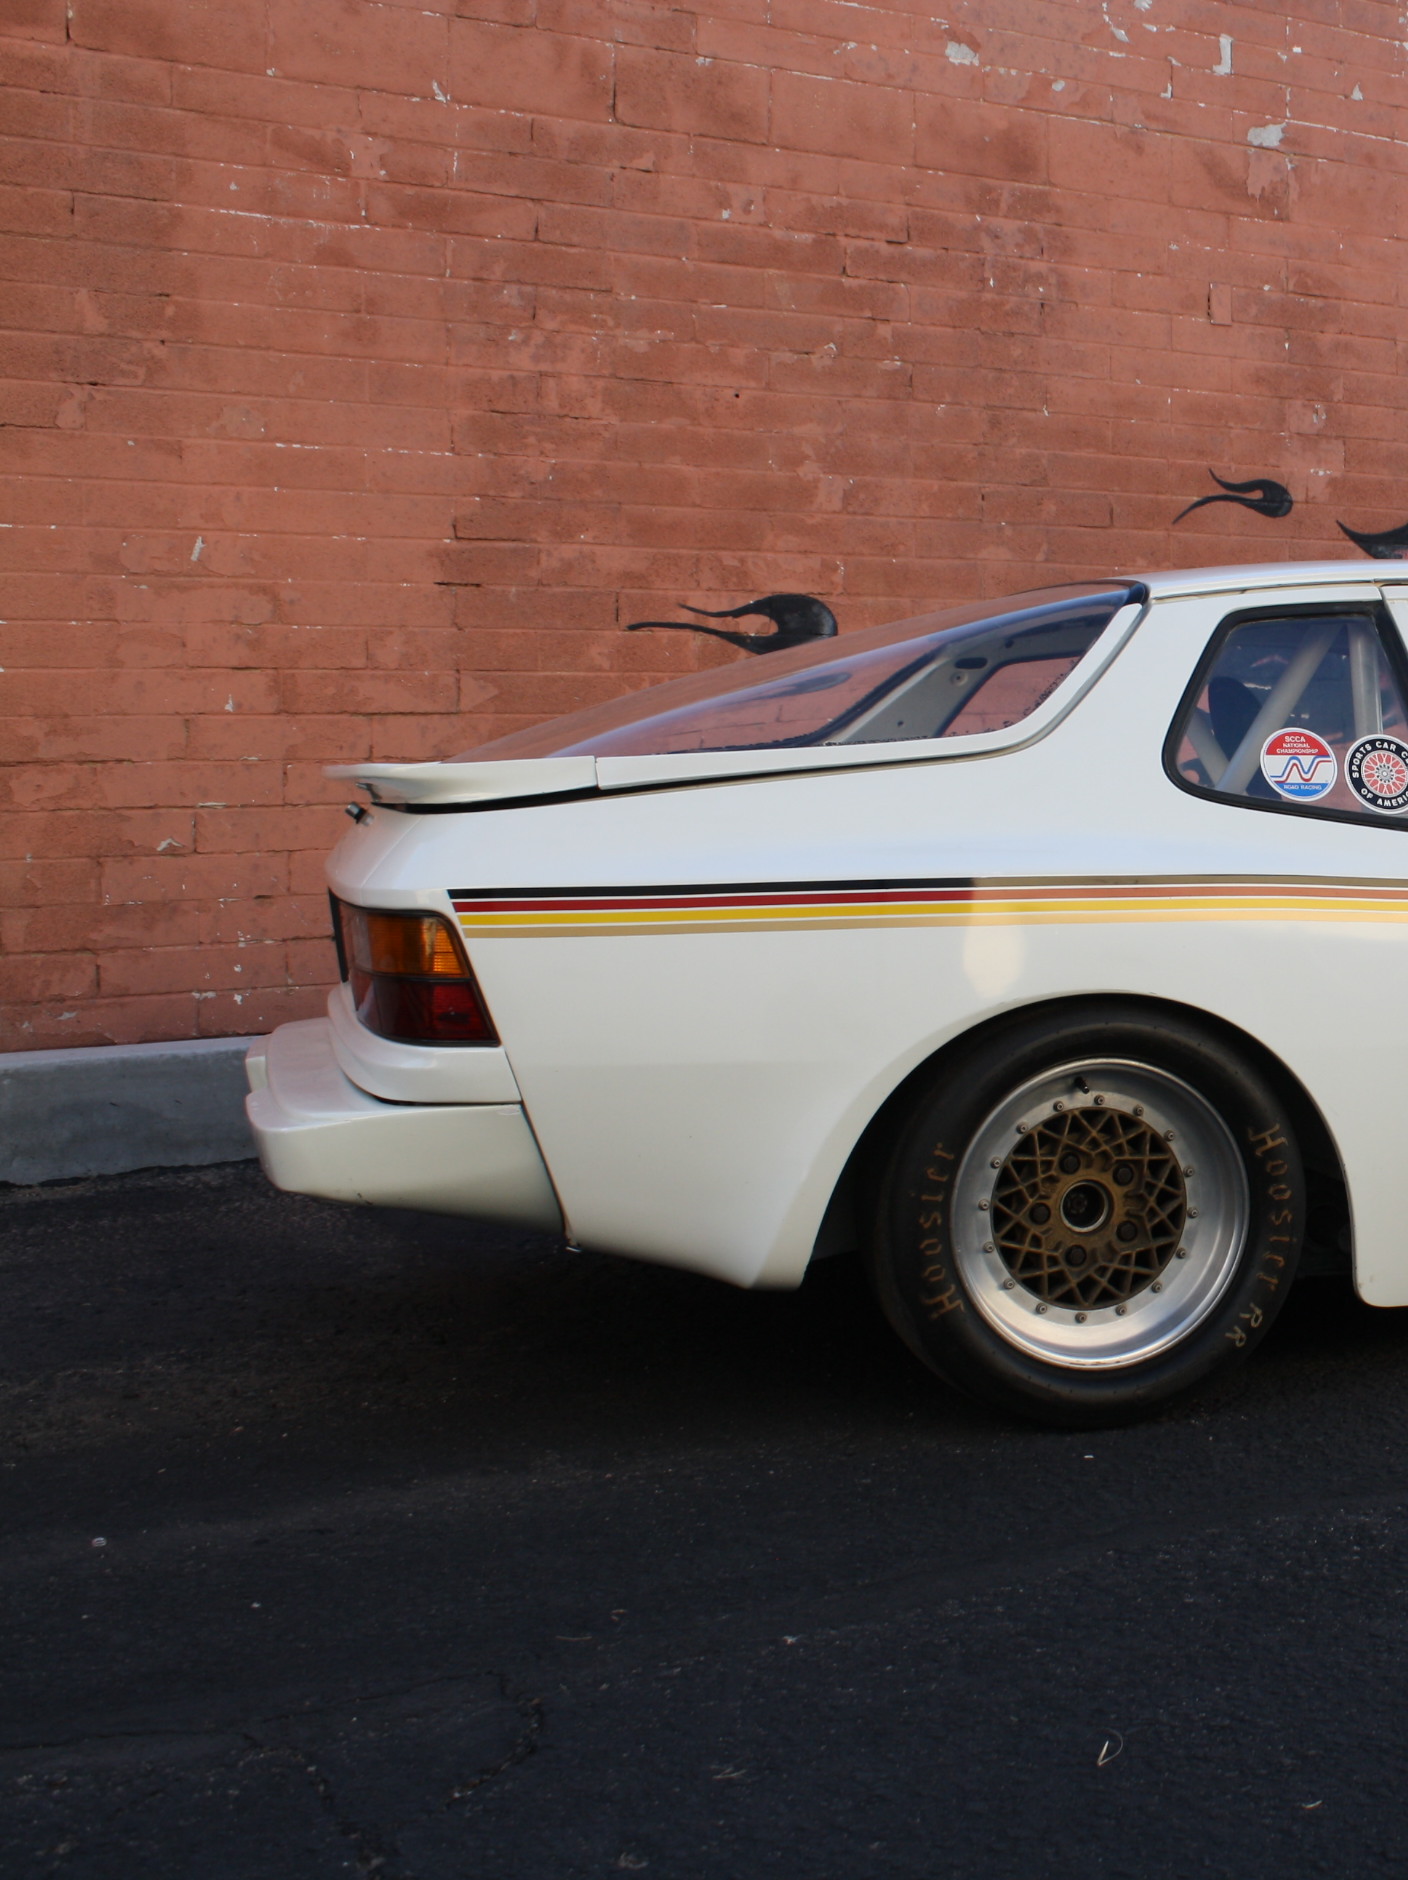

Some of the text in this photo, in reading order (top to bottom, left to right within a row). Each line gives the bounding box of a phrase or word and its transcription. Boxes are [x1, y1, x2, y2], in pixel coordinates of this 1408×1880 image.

[1284, 735, 1306, 743] SCCA
[1351, 743, 1372, 779] SPORTS
[1375, 741, 1397, 752] CAR
[1361, 787, 1374, 799] OF
